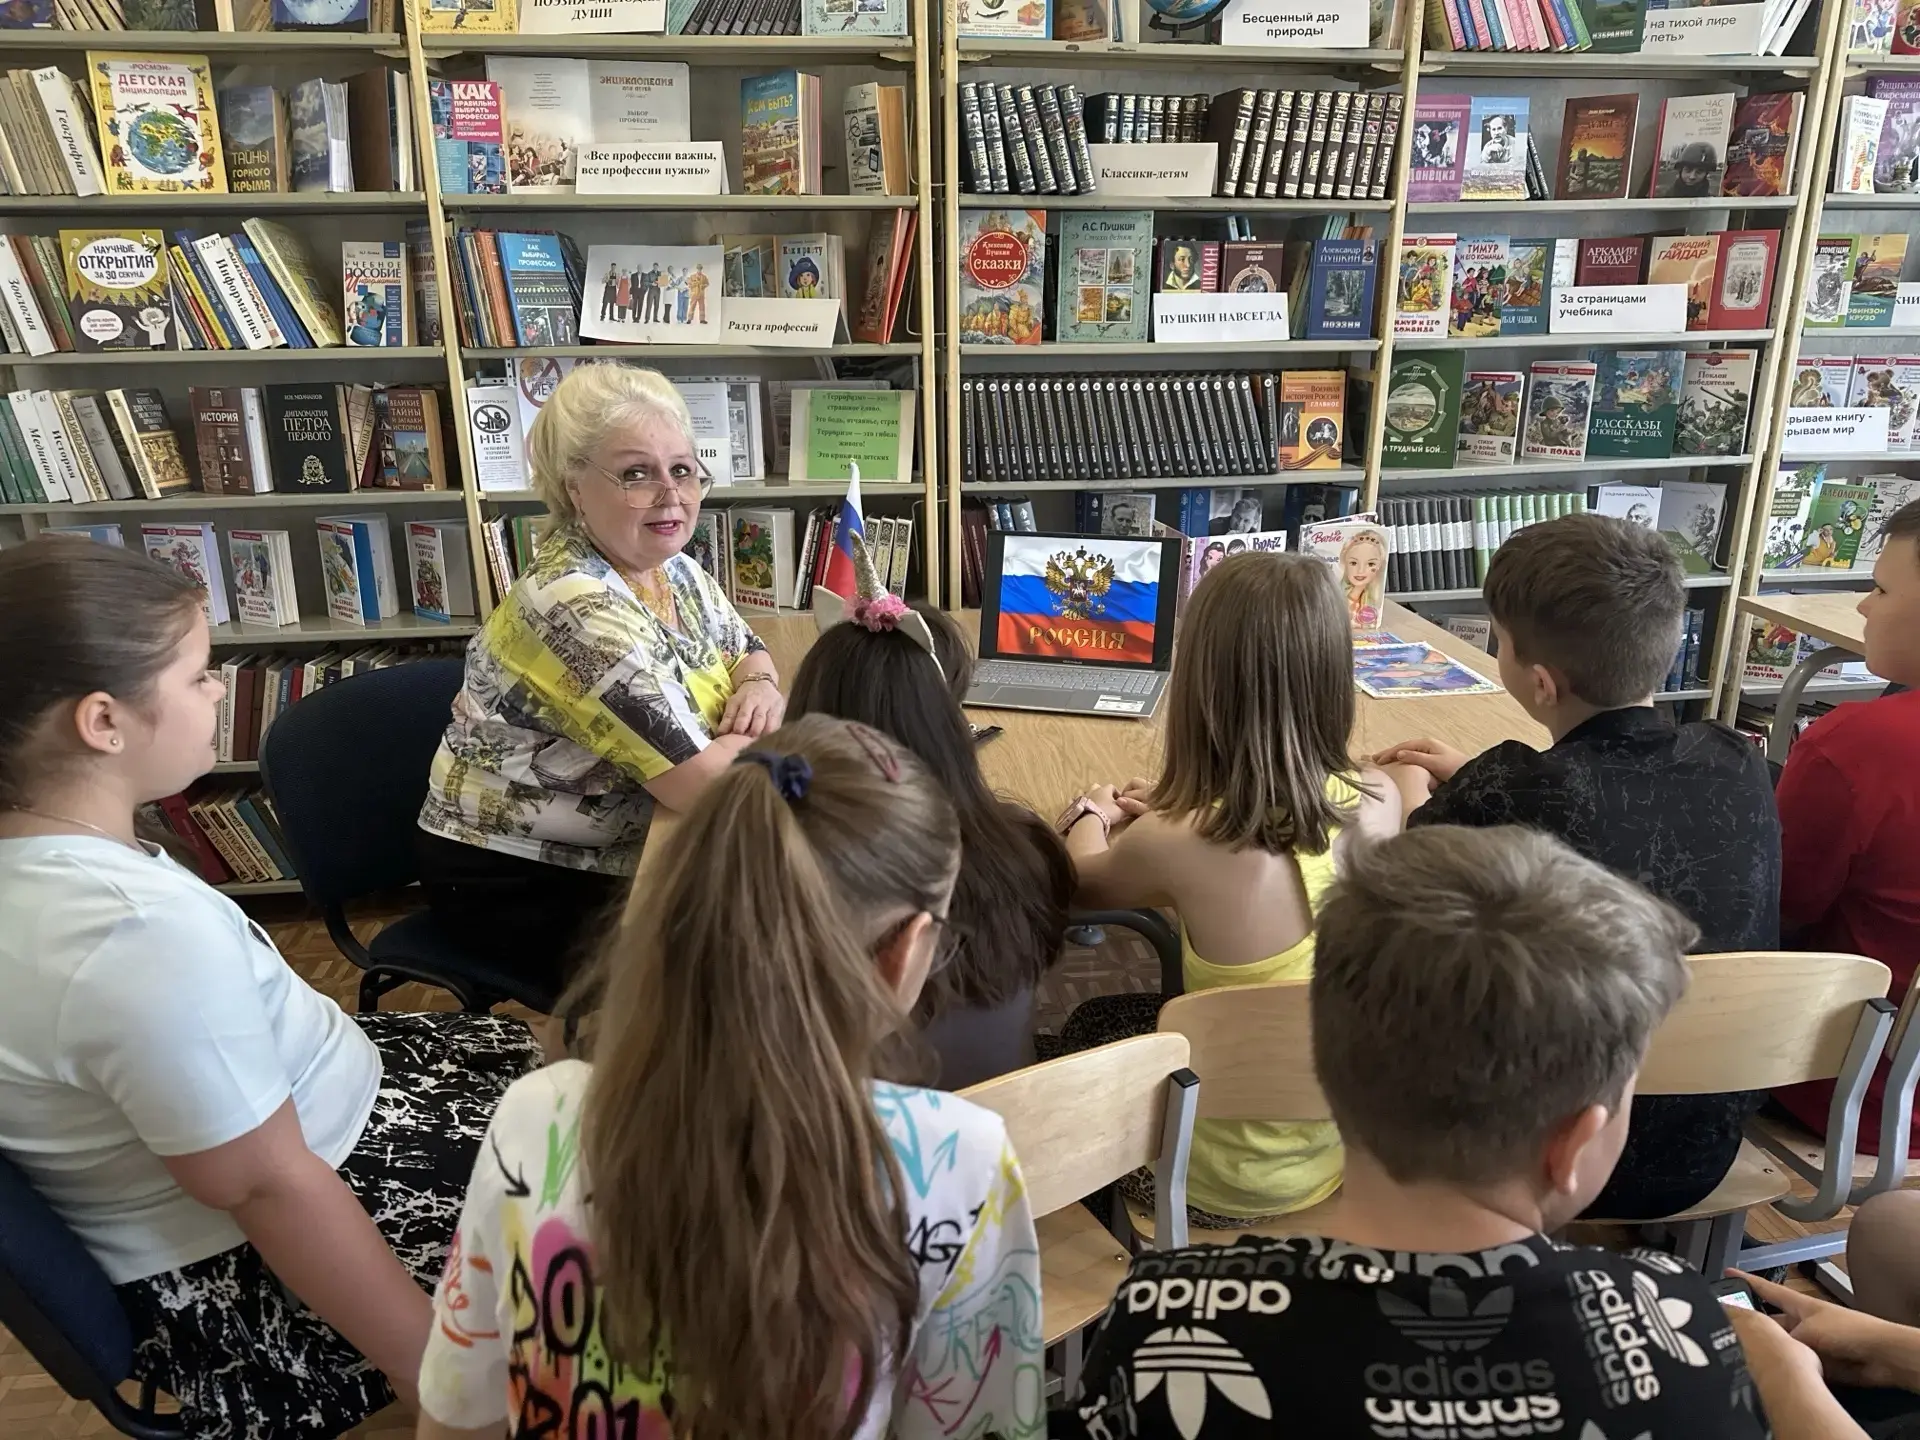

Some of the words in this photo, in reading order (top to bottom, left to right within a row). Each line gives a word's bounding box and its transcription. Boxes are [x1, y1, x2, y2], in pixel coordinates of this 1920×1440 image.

[571, 8, 613, 21] ДУШИ
[1242, 12, 1313, 24] Бесценный
[1316, 14, 1340, 24] дар
[1649, 20, 1665, 29] на
[1667, 17, 1703, 28] тихой
[1706, 17, 1736, 28] лире
[1266, 27, 1324, 38] природы
[1649, 33, 1684, 44] петь»
[39, 71, 56, 82] 26.8
[118, 74, 187, 87] ДЕТСКАЯ
[600, 76, 674, 87] ЭНЦИКЛОПЕДИЯ
[119, 87, 187, 98] ЭНЦИКЛОПЕДИЯ
[452, 84, 494, 100] КАК
[1705, 99, 1724, 108] ЧАС
[455, 113, 500, 121] ПРОФЕССИЮ
[1671, 109, 1723, 120] МУЖЕСТВА
[55, 108, 87, 176] География
[232, 150, 270, 165] ТАЙНЫ
[584, 151, 610, 162] «Все
[612, 151, 672, 163] профессии
[675, 152, 717, 162] важны,
[232, 167, 271, 178] ГОРНОГО
[581, 167, 600, 175] все
[602, 166, 662, 177] профессии
[664, 167, 710, 177] нужны»
[1100, 168, 1189, 179] Классики-детям
[233, 179, 271, 192] КРЫМА
[201, 237, 220, 250] 32.97
[527, 243, 540, 251] КАК
[1468, 244, 1499, 254] ТИМУР
[1670, 239, 1711, 249] АРКАДИЙ
[93, 244, 136, 255] НАУЧНЫЕ
[1321, 246, 1361, 255] Александр
[1587, 246, 1638, 256] АРКАДИЙ
[1657, 249, 1708, 261] ГАЙДАР
[521, 251, 550, 260] ВЫБИРАТЬ
[1319, 254, 1361, 264] ПУШКИН
[1590, 254, 1633, 266] ГАЙДАР
[79, 255, 155, 270] ОТКРЫТИЯ
[345, 260, 401, 268] УЧЕБНОЕ
[518, 259, 557, 268] ПРОФЕССИЮ
[973, 258, 1022, 270] Сказки
[94, 271, 105, 279] ЗА
[105, 271, 117, 280] 30
[118, 271, 145, 279] СЕКУНД
[345, 267, 402, 279] ПОСОБИЕ
[7, 278, 37, 331] Зоология
[215, 258, 262, 340] Информатика
[1560, 293, 1574, 304] За
[1576, 294, 1647, 305] страницами
[1160, 313, 1216, 325] ПУШКИН
[1219, 310, 1283, 323] НАВСЕГДА
[1559, 307, 1614, 319] учебника
[728, 320, 762, 332] Радуга
[764, 322, 819, 334] профессий
[1322, 321, 1361, 329] ПОЭЗИЯ
[1697, 371, 1727, 379] Поклон
[1687, 379, 1736, 388] победителям
[389, 399, 420, 407] ВЕЛИКИЕ
[200, 411, 239, 423] ИСТОРИЯ
[283, 410, 329, 418] ДИПЛОМАТИЯ
[391, 408, 421, 417] ТАЙНЫ
[1835, 412, 1866, 424] книгу
[283, 417, 332, 432] ПЕТРА
[1595, 418, 1662, 431] РАССКАЗЫ
[288, 430, 331, 441] ПЕРВОГО
[1599, 428, 1628, 437] ЮНЫХ
[1630, 430, 1663, 438] ГЕРОЯХ
[1784, 427, 1830, 437] рываем
[1833, 425, 1855, 435] мир
[480, 433, 510, 444] НЕТ
[1389, 444, 1424, 453] ТРУДНЫЙ
[1526, 446, 1547, 454] СЫН
[1549, 448, 1581, 457] ПОЛКА
[28, 427, 56, 485] Медицина
[51, 430, 76, 479] История
[816, 451, 829, 459] Это
[1311, 530, 1344, 548] Barbie
[735, 594, 775, 609] КОЛОБКИ
[1029, 626, 1127, 651] РОССИЯ
[1586, 1269, 1661, 1401] adidas
[1364, 1355, 1554, 1396] adidas
